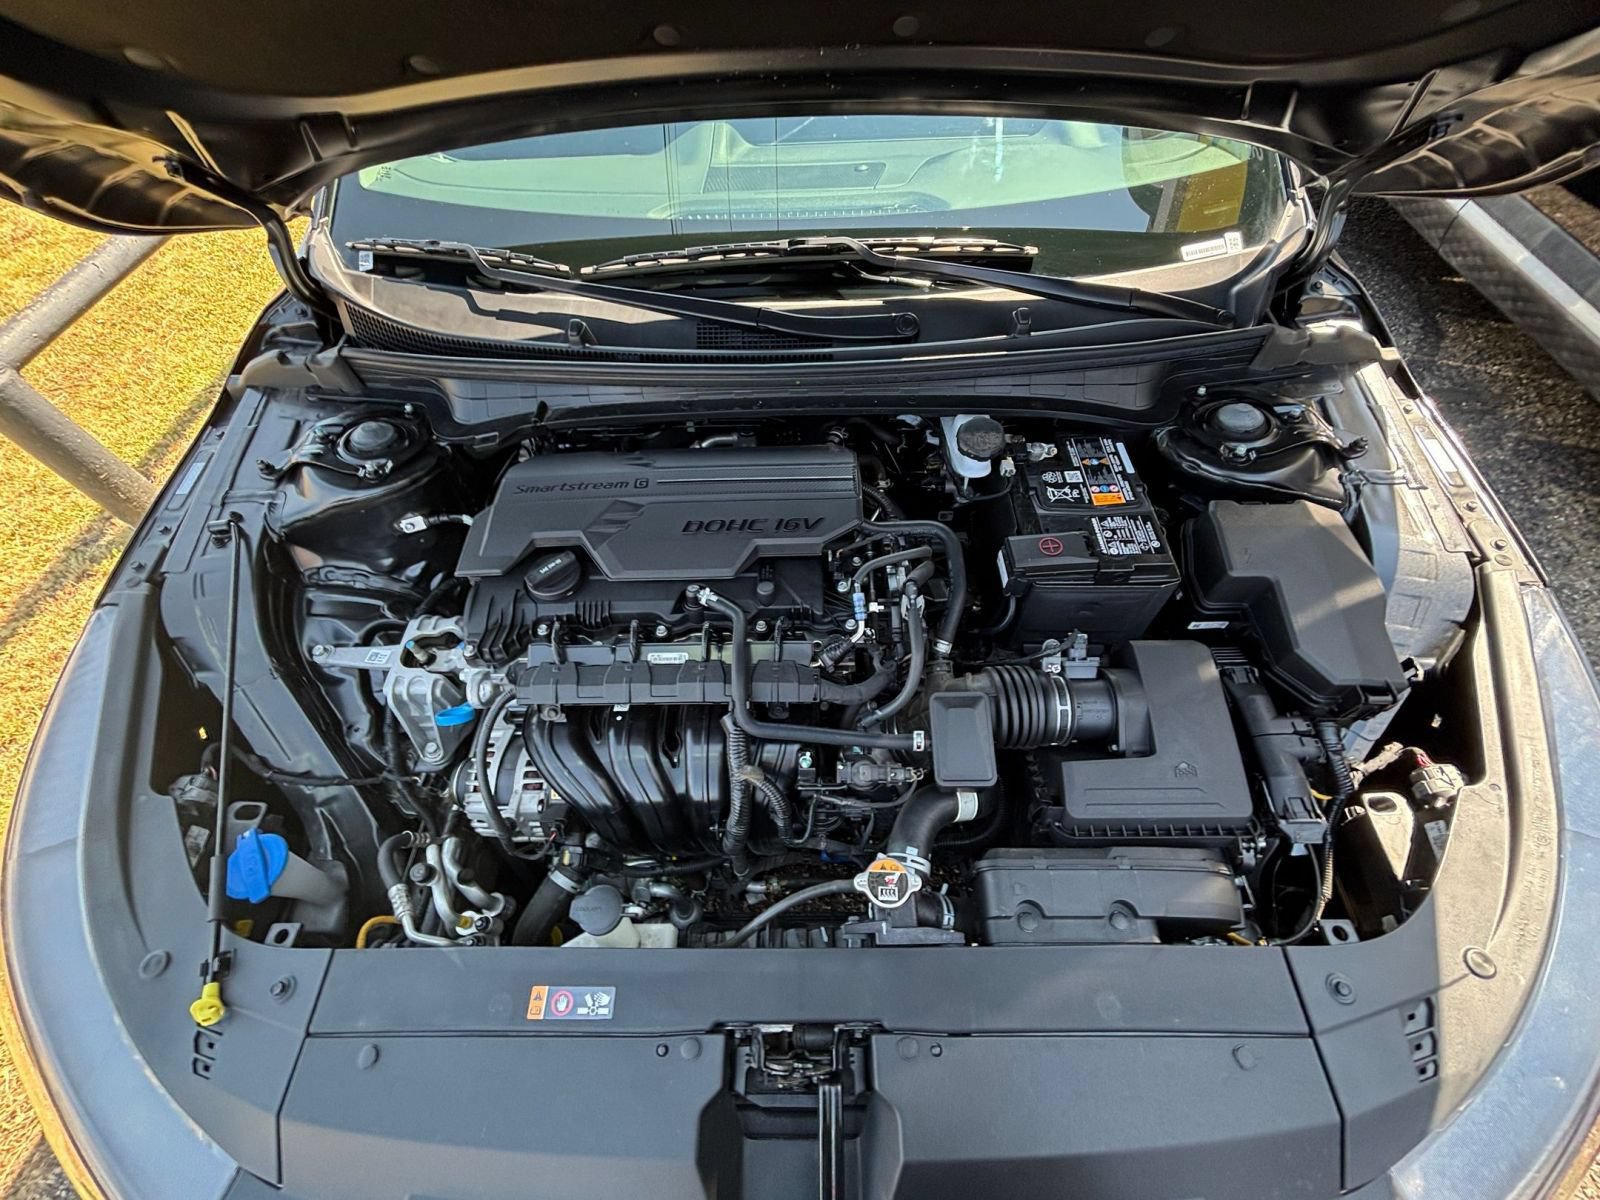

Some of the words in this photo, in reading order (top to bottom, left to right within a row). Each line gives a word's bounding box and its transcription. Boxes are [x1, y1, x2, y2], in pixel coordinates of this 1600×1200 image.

[513, 480, 630, 495] Smartstream
[681, 518, 768, 533] DOHC
[774, 516, 825, 532] 16V
